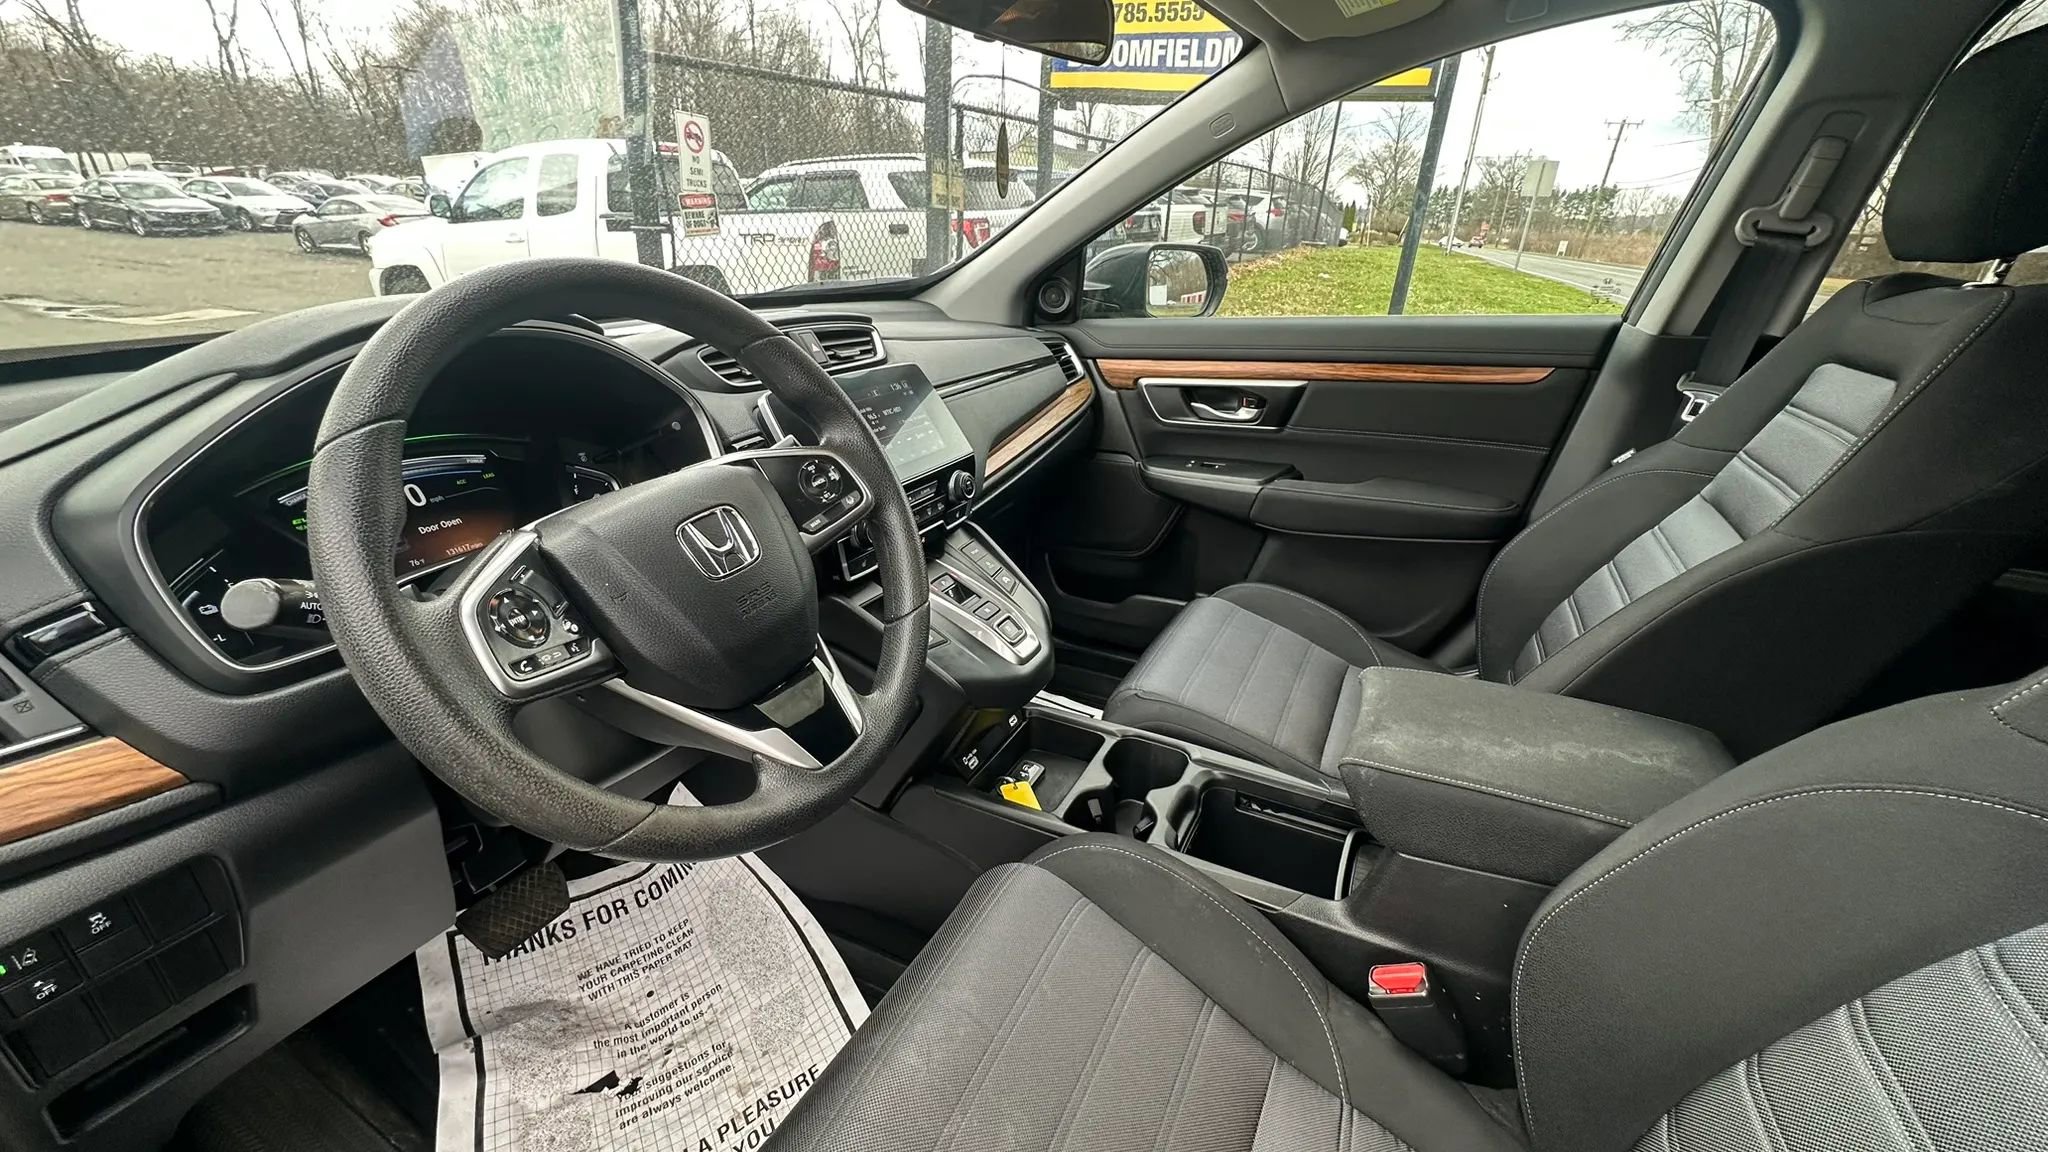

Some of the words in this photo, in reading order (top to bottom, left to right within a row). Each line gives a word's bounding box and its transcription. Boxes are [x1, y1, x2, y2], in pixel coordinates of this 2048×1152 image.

[1068, 37, 1243, 68] OMFIELDM
[686, 178, 708, 188] TRUCKS
[690, 167, 704, 176] SEMI
[740, 233, 776, 246] TRD
[403, 483, 427, 507] 0
[418, 523, 440, 535] Door
[440, 518, 463, 528] Open
[446, 543, 470, 556] 131617
[300, 602, 323, 611] AUTO
[91, 920, 112, 935] OFF
[482, 919, 577, 966] ANKS
[582, 898, 630, 931] FOR
[634, 862, 697, 908] COMIN
[577, 968, 593, 981] WE
[595, 956, 621, 973] HAVE
[623, 941, 652, 960] TRIED
[653, 934, 666, 945] TO
[667, 918, 689, 937] KEEP
[578, 973, 608, 993] YOUR
[610, 946, 664, 977] CARPETING
[665, 927, 694, 950] CLEAN
[588, 983, 615, 1001] WITH
[617, 969, 640, 987] THIS
[641, 953, 673, 974] PAPER
[673, 940, 694, 957] MAT
[36, 985, 58, 1000] OFF
[624, 1022, 632, 1030] A
[633, 999, 679, 1029] customer
[680, 991, 690, 1002] is
[593, 1038, 610, 1049] the
[613, 1033, 641, 1046] most
[641, 1004, 690, 1039] important
[690, 983, 723, 1011] person
[616, 1049, 627, 1059] in
[629, 1043, 647, 1055] the
[649, 1024, 679, 1045] world
[679, 1018, 691, 1028] to
[615, 1084, 673, 1118] improving
[675, 1072, 693, 1088] our
[695, 1050, 734, 1077] service
[645, 1049, 710, 1089] suggestions
[711, 1040, 726, 1053] for
[619, 1115, 638, 1130] are
[641, 1094, 682, 1119] always
[684, 1064, 735, 1097] welcome.
[699, 1137, 713, 1152] A
[716, 1063, 819, 1143] PLEASURE
